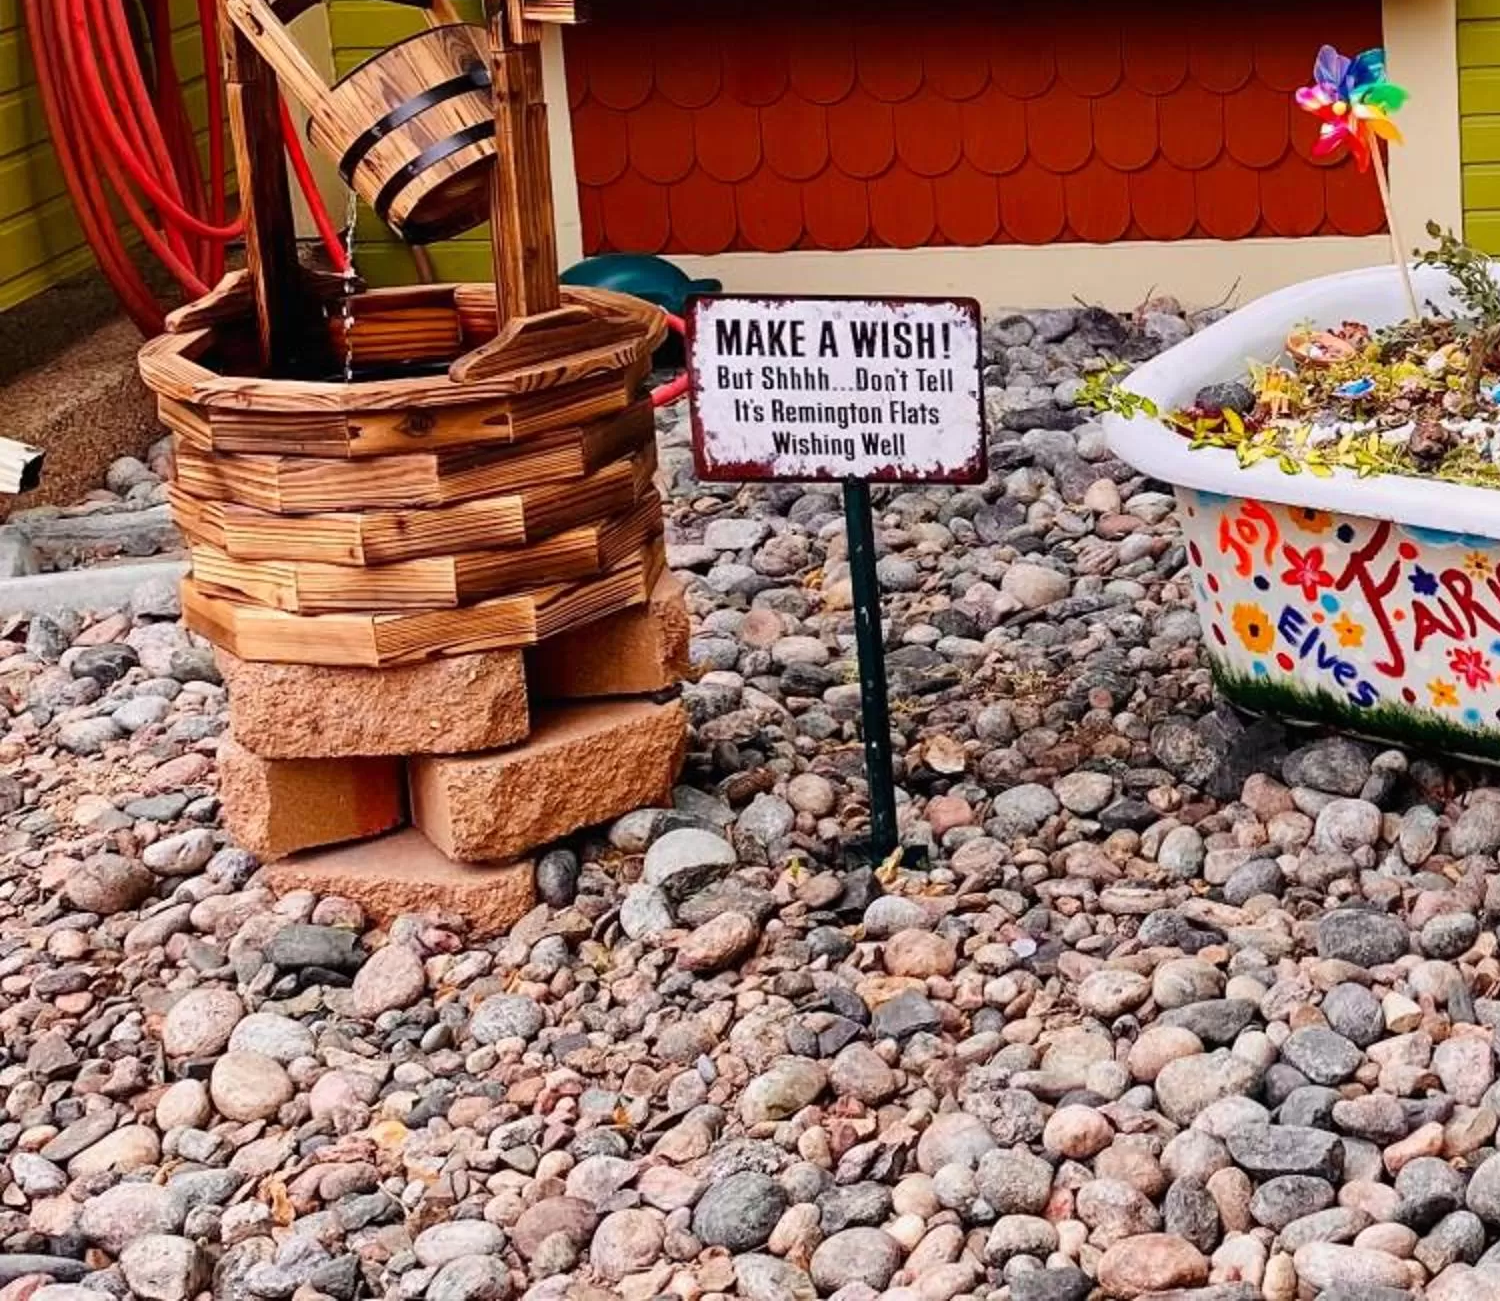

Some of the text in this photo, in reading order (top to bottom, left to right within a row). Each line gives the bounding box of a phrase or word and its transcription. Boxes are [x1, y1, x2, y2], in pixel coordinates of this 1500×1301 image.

[715, 319, 951, 360] MAKE A WISH!
[717, 365, 754, 390] But
[916, 368, 953, 393] Tell
[734, 398, 939, 429] It's Remington Flats
[772, 432, 906, 461] Wishing Well
[1277, 605, 1381, 708] Elves
